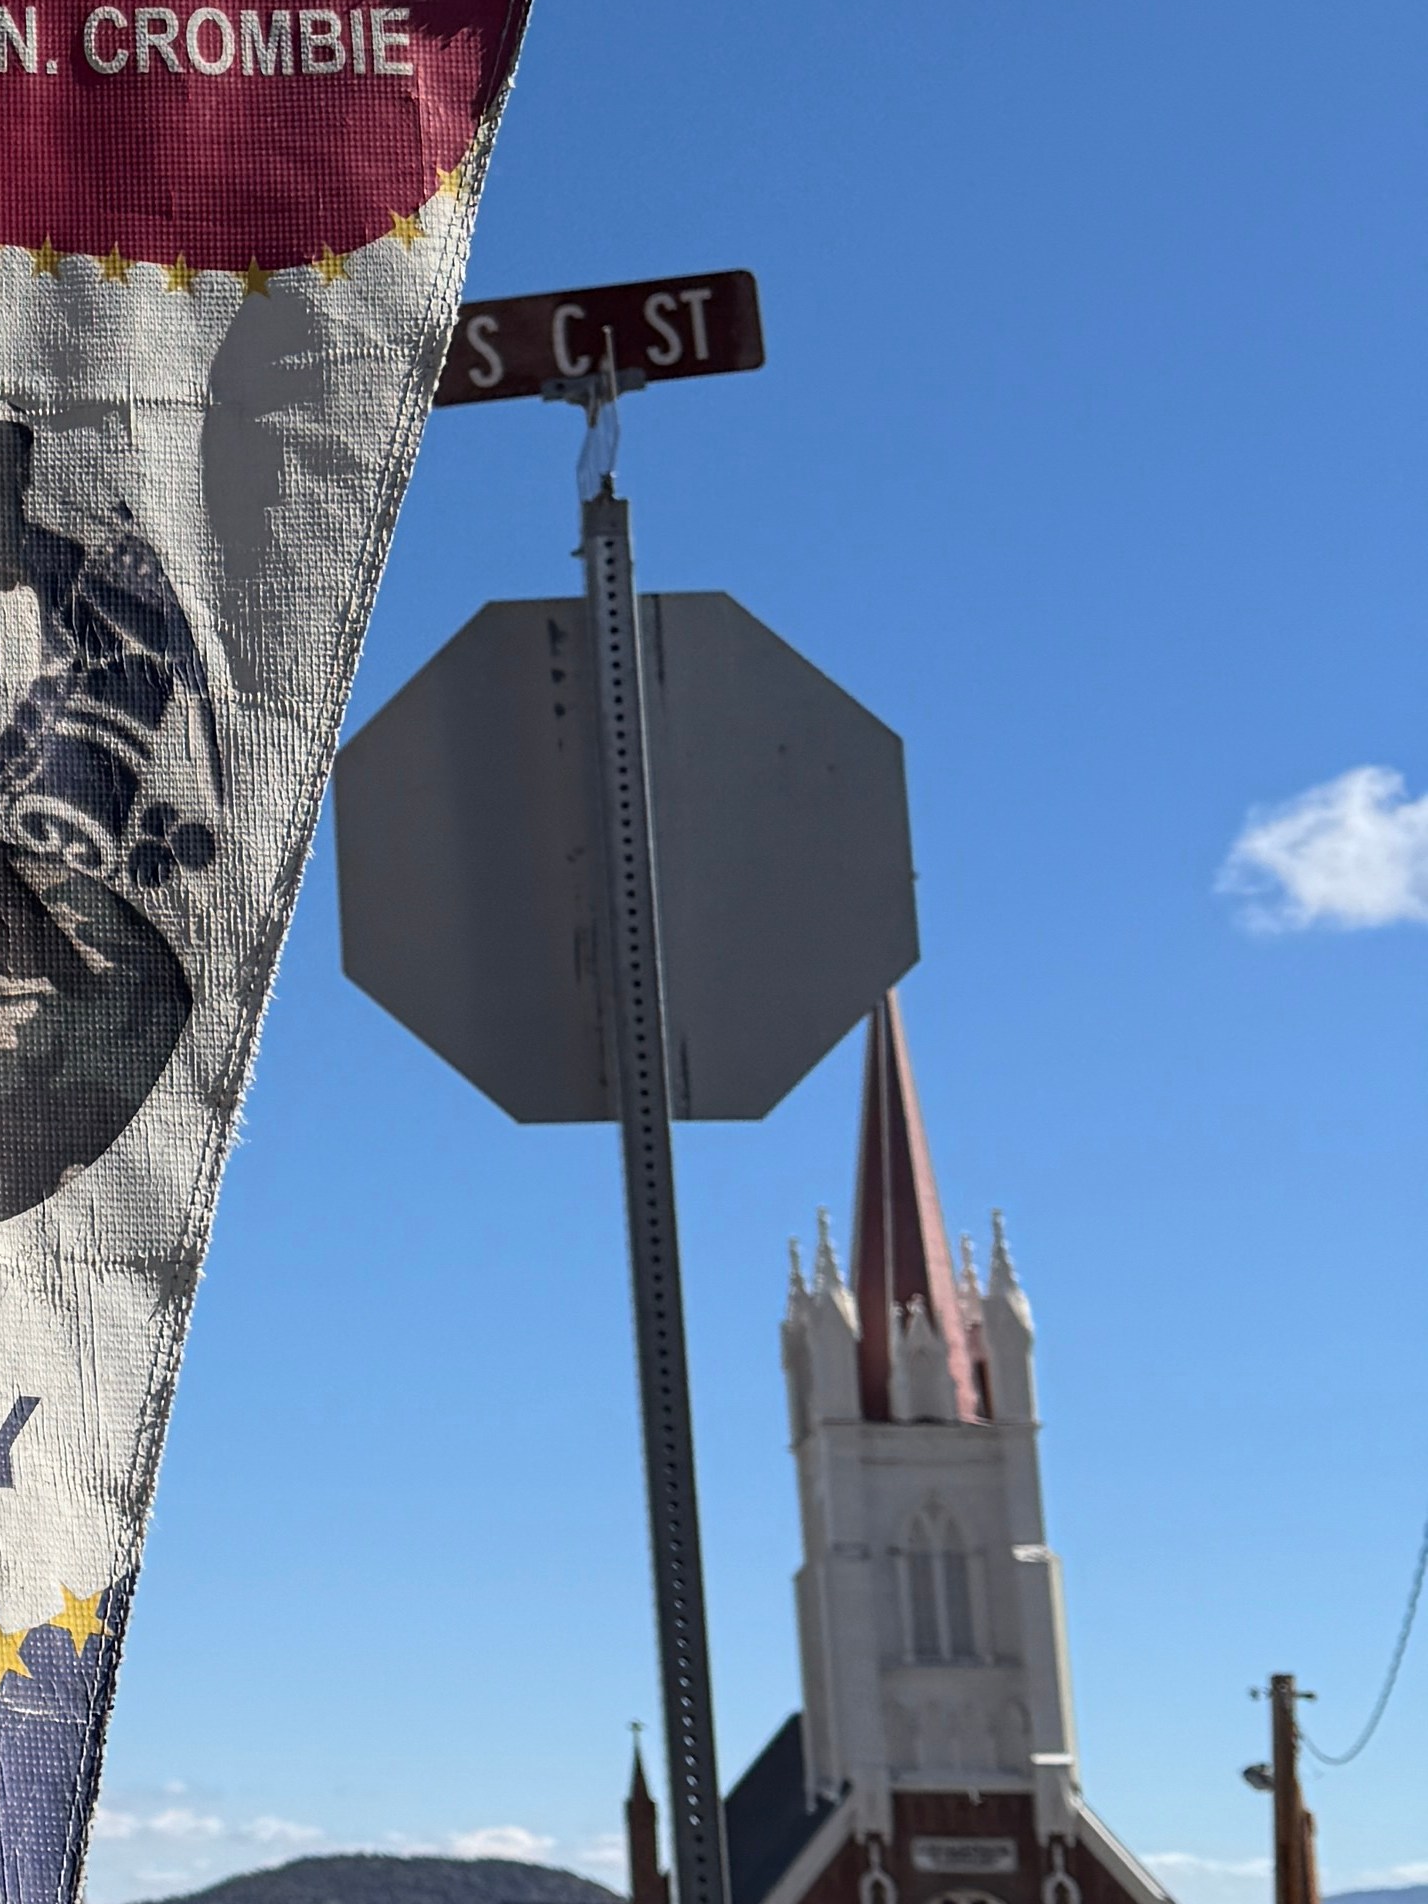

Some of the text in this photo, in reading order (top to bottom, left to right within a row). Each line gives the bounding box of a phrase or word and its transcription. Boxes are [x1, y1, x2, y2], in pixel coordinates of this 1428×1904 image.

[82, 5, 414, 78] CROMBIE
[465, 289, 712, 388] S C ST
